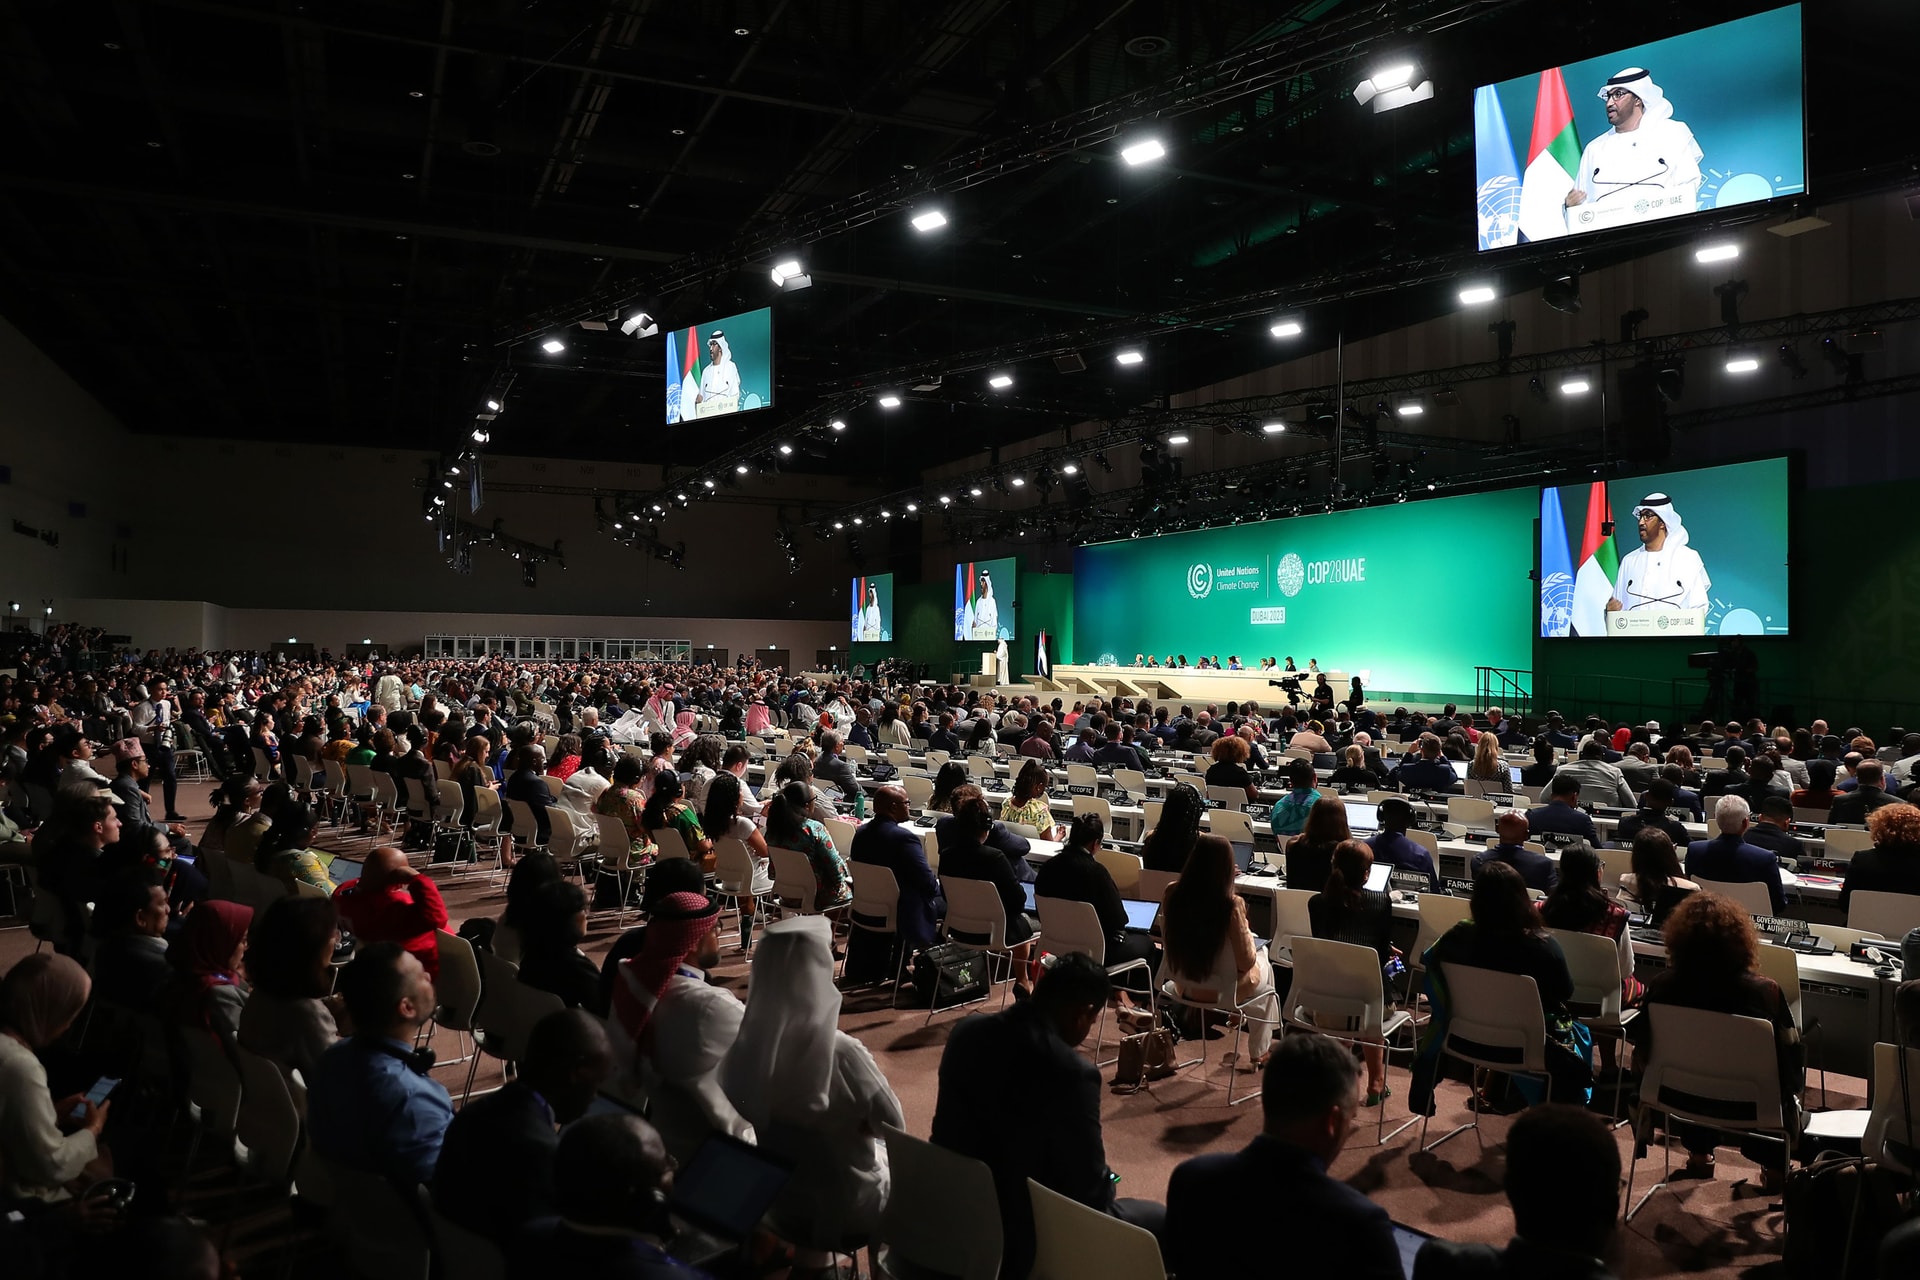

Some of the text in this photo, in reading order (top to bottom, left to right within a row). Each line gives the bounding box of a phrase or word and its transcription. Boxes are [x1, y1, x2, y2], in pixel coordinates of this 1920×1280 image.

[1216, 565, 1259, 577] United Nations
[1307, 558, 1366, 584] COP28UAE
[1216, 580, 1260, 591] Climate Change
[1252, 610, 1284, 621] DUBAI 2023
[1813, 859, 1835, 869] IFRC
[1756, 916, 1799, 928] GOVERNMENTS
